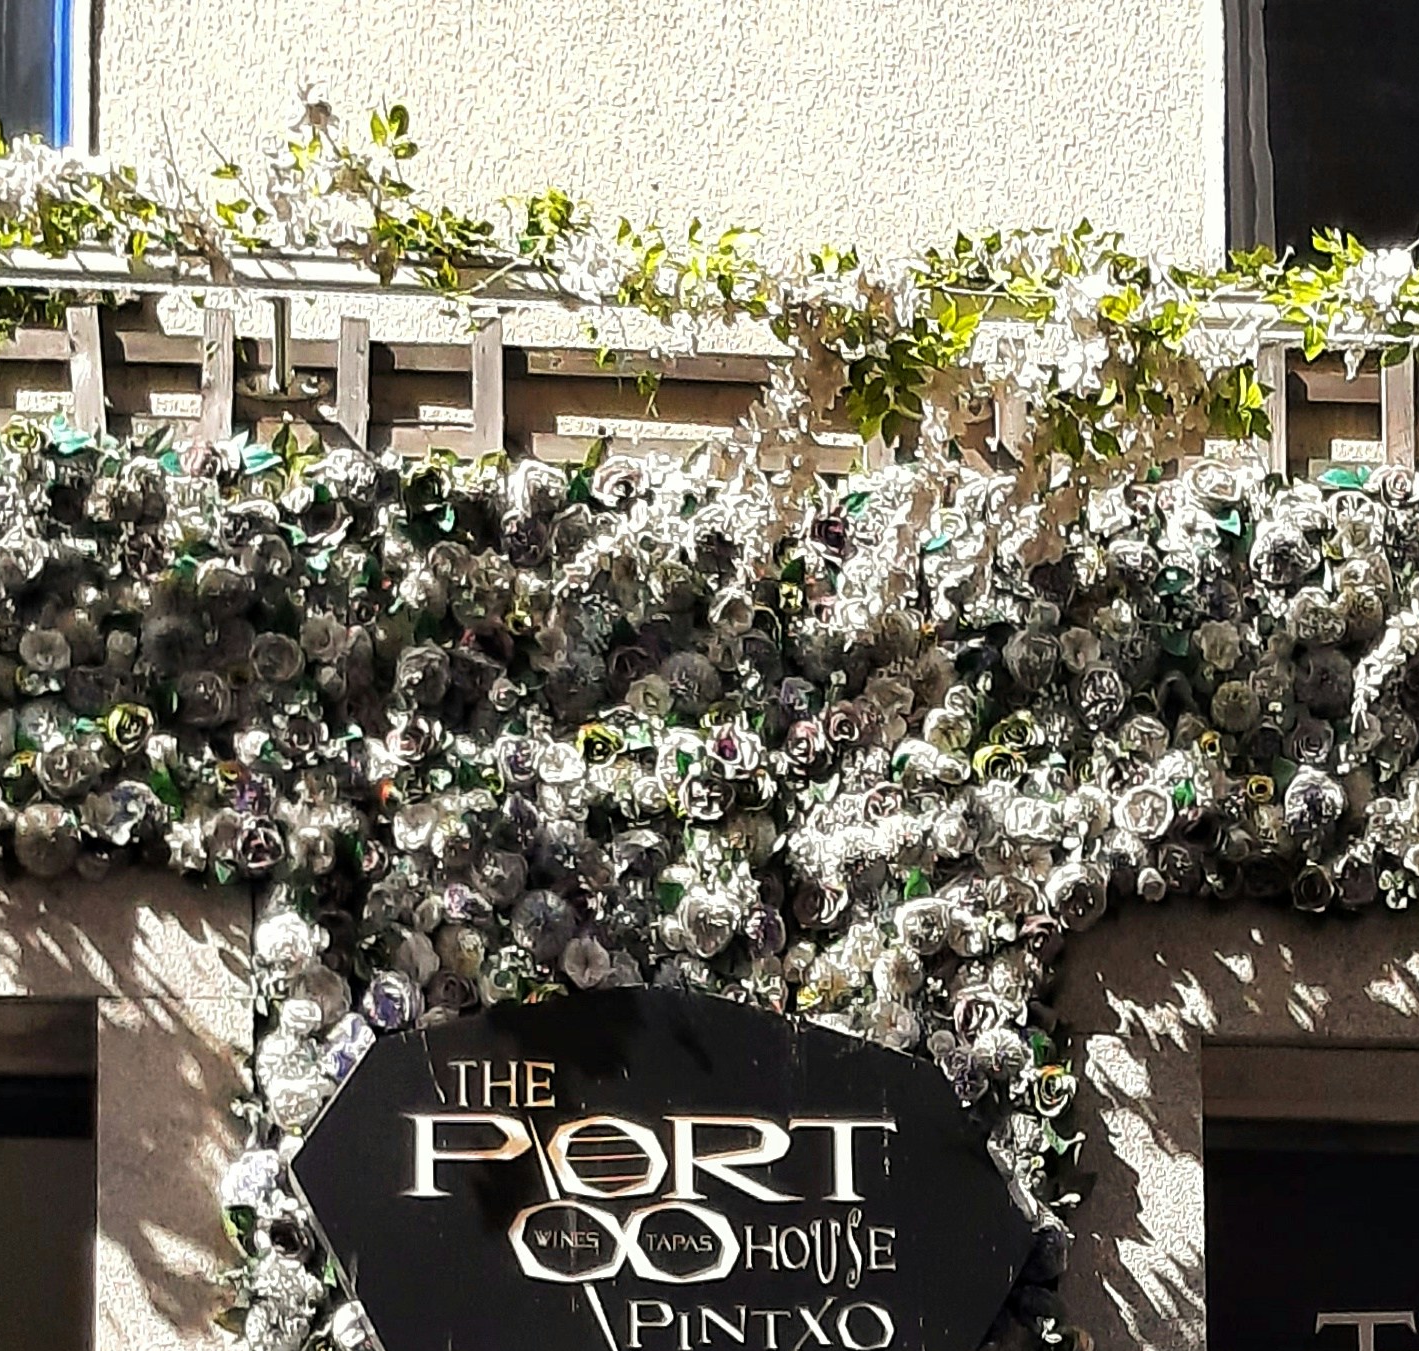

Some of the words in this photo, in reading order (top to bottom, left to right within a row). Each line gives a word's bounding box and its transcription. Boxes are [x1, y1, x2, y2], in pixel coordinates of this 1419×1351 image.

[449, 1061, 556, 1108] THE
[402, 1115, 898, 1202] PORT
[533, 1230, 599, 1256] WINES
[646, 1233, 713, 1252] TAPAS
[744, 1207, 897, 1289] HOUSE
